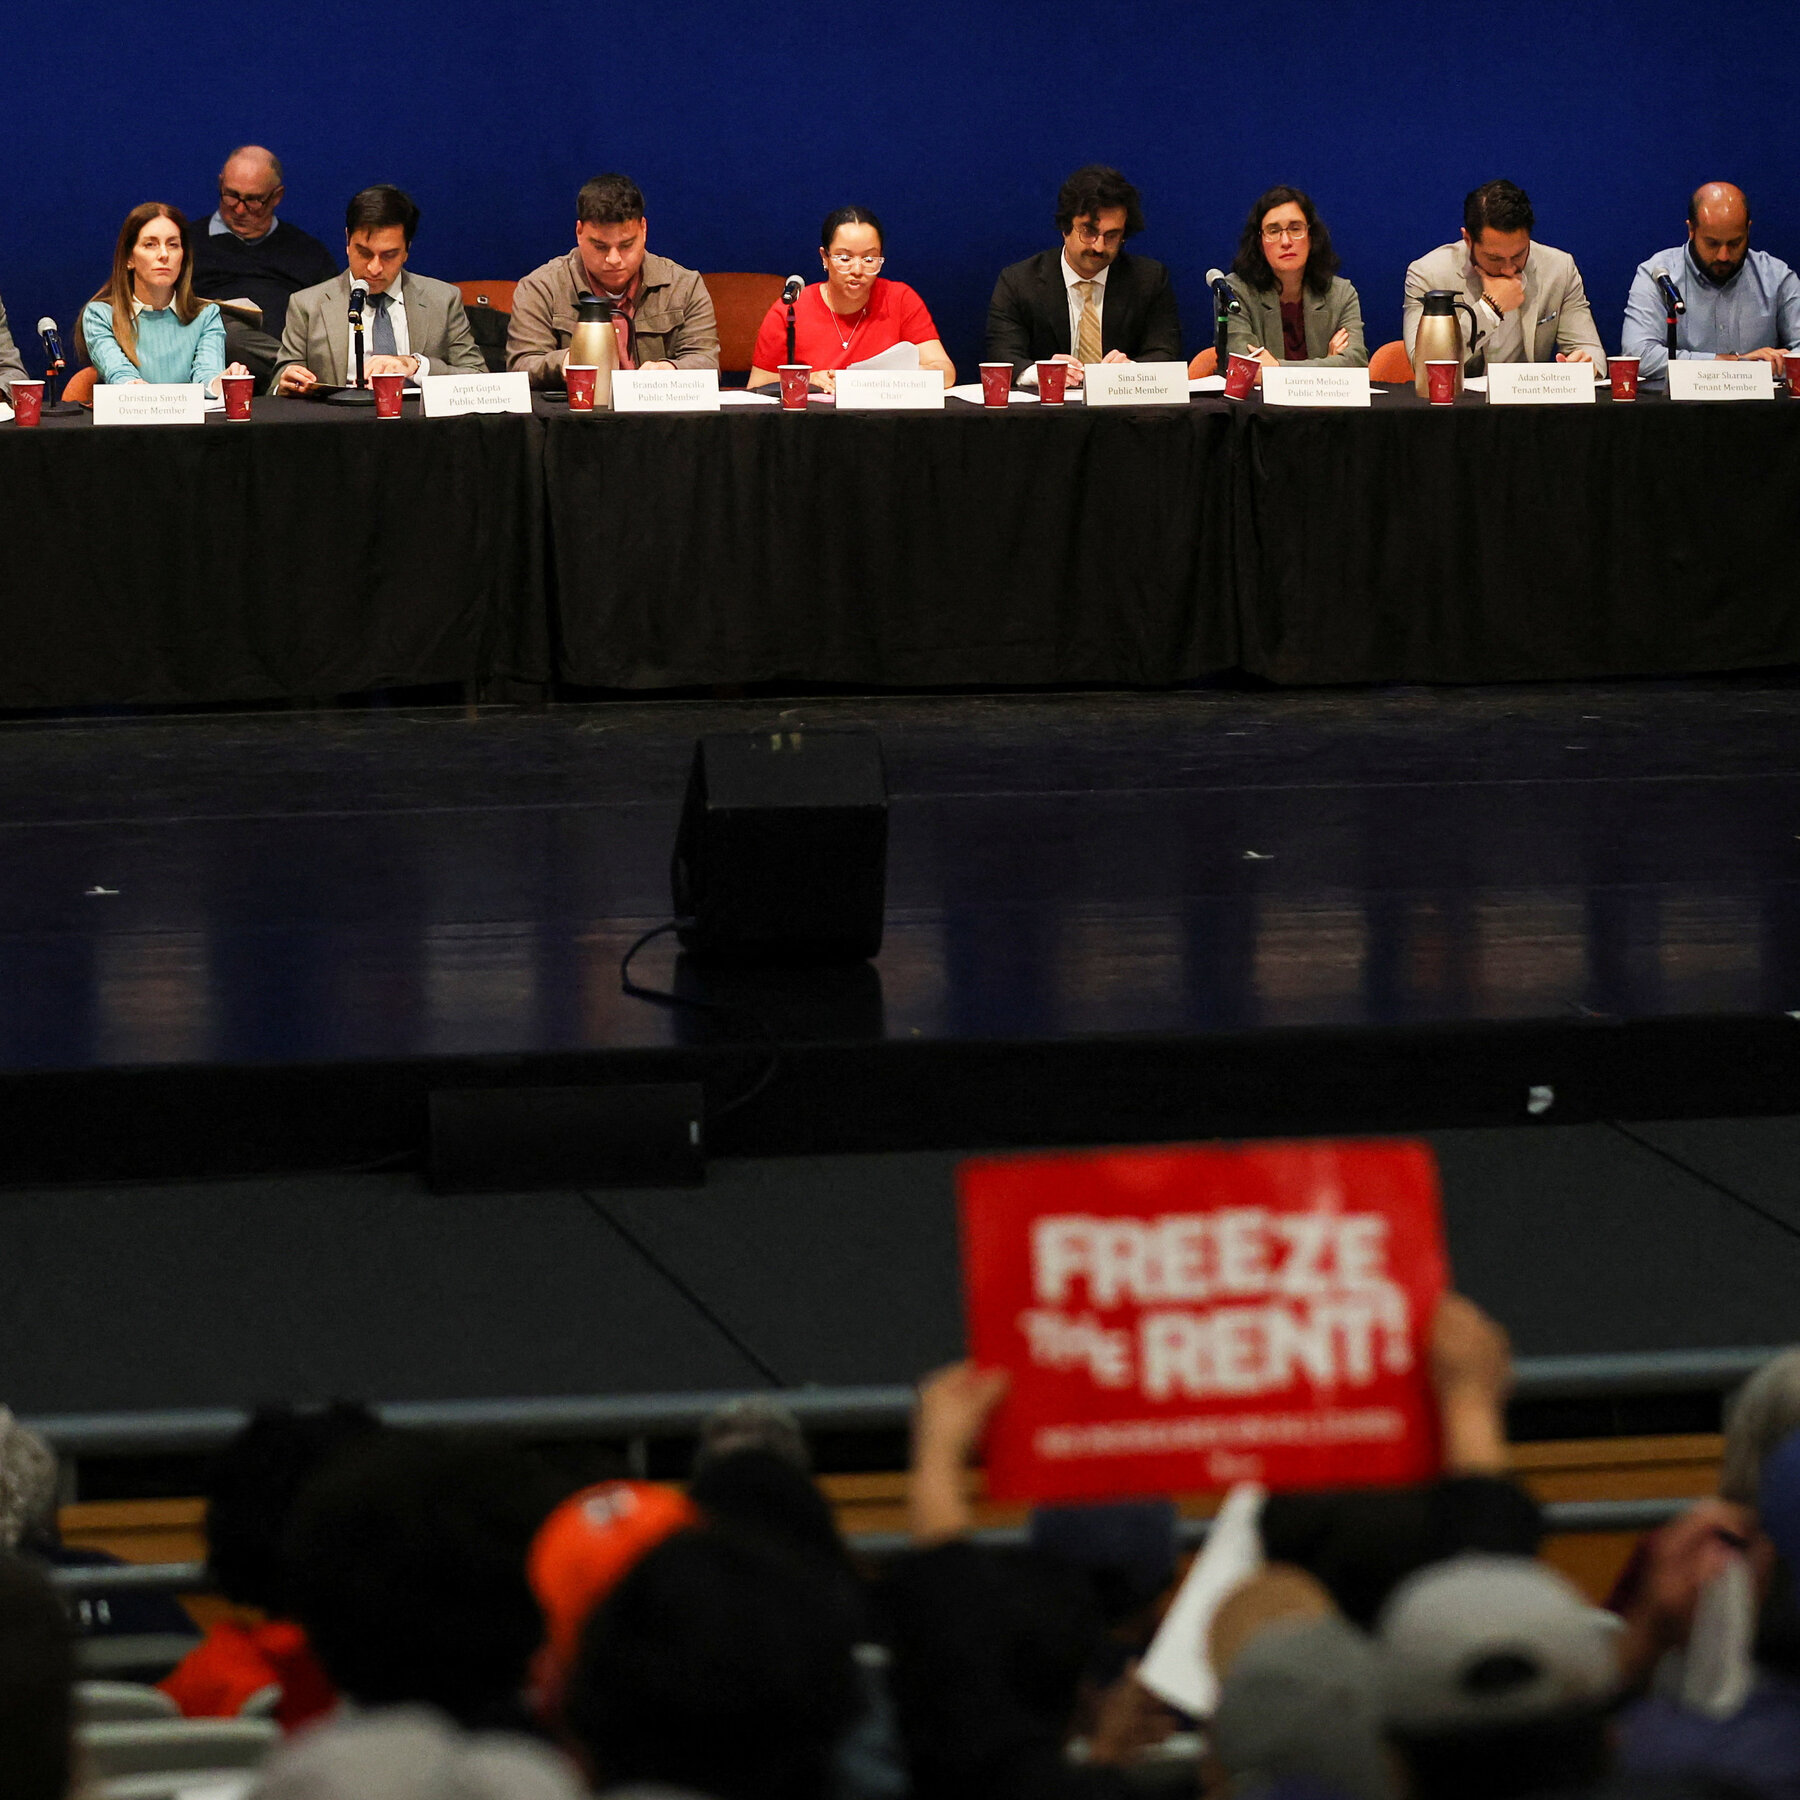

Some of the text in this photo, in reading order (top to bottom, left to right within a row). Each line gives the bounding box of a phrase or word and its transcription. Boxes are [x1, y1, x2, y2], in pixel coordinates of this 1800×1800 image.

[1118, 374, 1157, 382] Sina Sinai
[1517, 374, 1571, 382] Adan Soltren
[1697, 371, 1753, 380] Sagar Sharma
[633, 381, 668, 389] Brandon
[892, 380, 926, 388] Mitchell
[1284, 378, 1349, 386] Lauren Melodia
[452, 384, 501, 394] Arpit Gupta
[1108, 386, 1168, 395] Public Member
[1512, 386, 1577, 394] Tenant Member
[1693, 383, 1757, 391] Tenant Member
[19, 388, 36, 406] LATTE
[638, 393, 700, 402] Public Member
[880, 392, 903, 400] Chair
[1287, 390, 1350, 398] Public Member
[118, 394, 188, 404] Christina Smyth
[449, 396, 511, 406] Public Member
[119, 407, 186, 415] Owner Member
[1033, 1208, 1390, 1305] FREEZE
